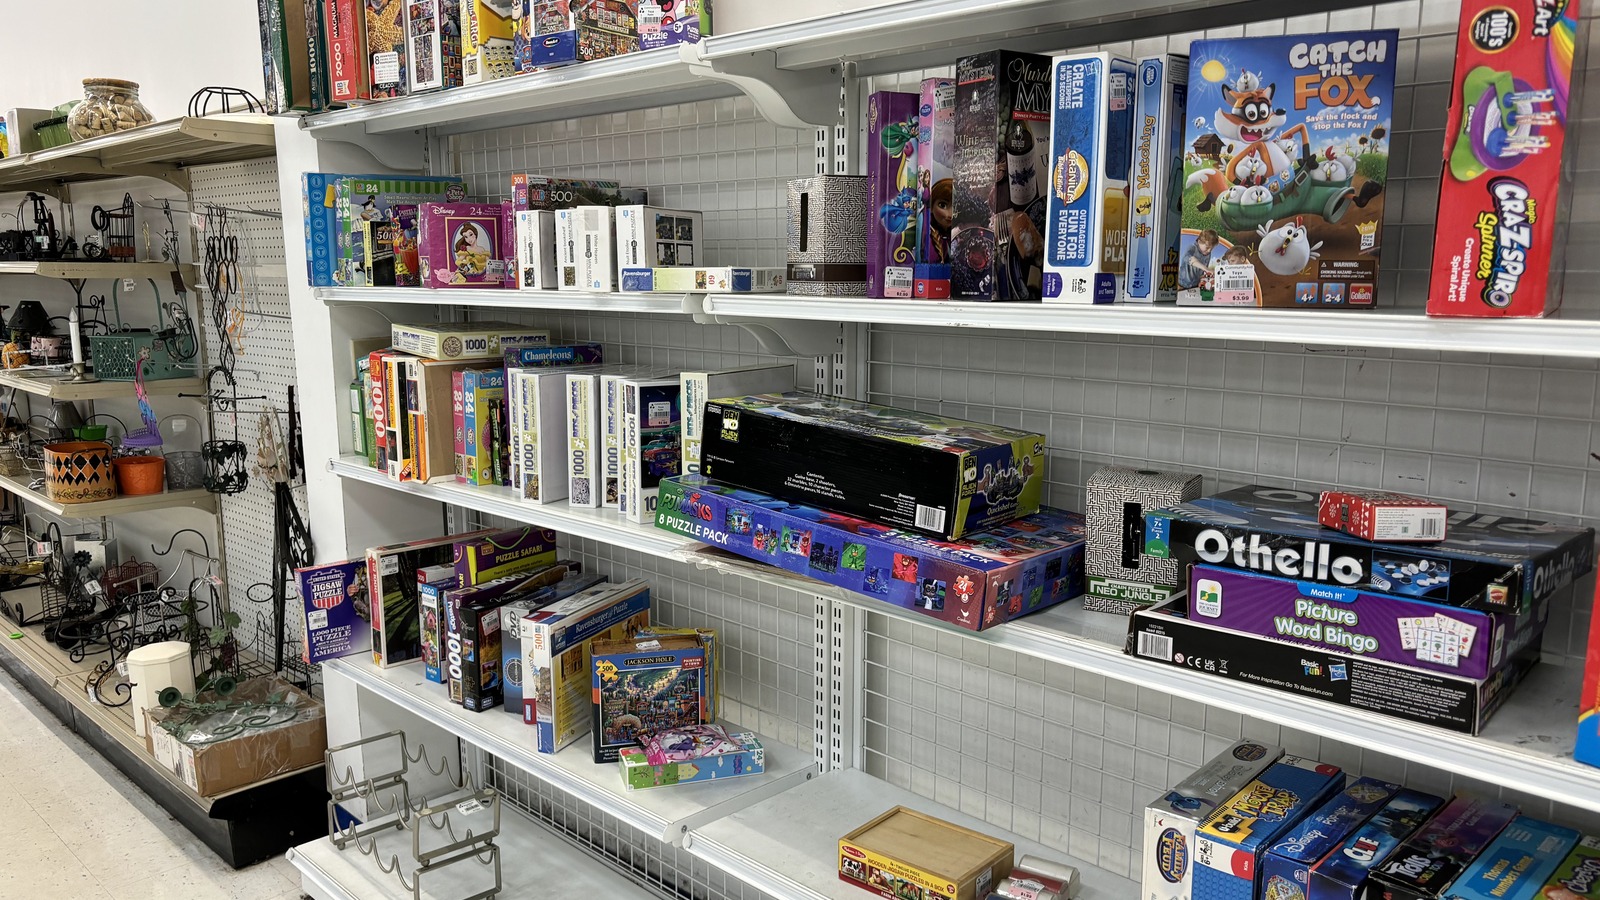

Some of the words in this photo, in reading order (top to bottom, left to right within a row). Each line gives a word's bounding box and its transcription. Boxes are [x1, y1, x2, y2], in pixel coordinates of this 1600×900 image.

[331, 1, 340, 38] MAGNUM
[1489, 12, 1508, 48] 100's
[642, 32, 668, 42] Puzzle
[308, 37, 316, 73] 1000
[334, 42, 342, 77] 2000
[580, 46, 594, 56] 500
[1290, 40, 1387, 69] CATCH
[1319, 62, 1353, 78] THE
[1072, 64, 1084, 109] CREATE
[1294, 74, 1380, 110] FOX
[1314, 123, 1331, 131] stop
[1347, 120, 1367, 129] Fox!
[1137, 116, 1155, 189] Matching
[365, 184, 378, 193] 24
[431, 206, 456, 216] Disney
[470, 206, 483, 216] 24
[1067, 210, 1077, 234] FUN
[1525, 199, 1536, 224] Magic
[1057, 210, 1067, 260] EVERYONE
[1077, 209, 1086, 259] OUTRAGEOUS
[1105, 230, 1126, 244] WOR
[1066, 237, 1076, 259] FOR
[1463, 238, 1474, 269] Create
[1474, 212, 1498, 279] Spinner
[1449, 256, 1461, 283] Spiral
[1448, 284, 1457, 302] Art!
[1459, 269, 1469, 302] Unique
[1325, 294, 1341, 302] 2-4
[464, 339, 486, 350] 1000
[524, 349, 572, 361] Chameleons
[490, 376, 502, 386] 24
[372, 376, 386, 438] 1000
[453, 390, 463, 412] 24
[464, 391, 474, 413] 24
[723, 419, 739, 430] 10
[724, 411, 739, 420] BEN
[524, 444, 534, 471] 1000
[573, 450, 584, 476] 1000
[608, 447, 618, 475] 1000
[964, 457, 977, 468] BEN
[402, 462, 412, 476] NEW
[964, 468, 976, 482] 10
[962, 483, 977, 492] ALIEN
[661, 493, 676, 510] PJ
[675, 493, 713, 521] MASKS
[659, 514, 664, 524] 8
[666, 515, 701, 536] PUZZLE
[703, 527, 729, 545] PACK
[495, 551, 519, 563] PUZZLE
[521, 545, 543, 557] SAFARI
[1195, 529, 1363, 585] Othello
[312, 581, 343, 592] JIGSAW
[488, 571, 532, 587] 1000
[958, 581, 967, 592] 24
[314, 588, 343, 600] PUZZLE
[422, 586, 434, 595] 1000
[1096, 586, 1118, 596] NEO
[1120, 588, 1163, 601] JUNGLE
[1310, 588, 1333, 598] Match
[447, 601, 456, 630] Prestige
[576, 611, 610, 632] Ravensburger
[613, 601, 629, 615] Puzzle
[1296, 600, 1357, 624] Picture
[312, 630, 352, 643] PUZZLE
[329, 625, 351, 633] PIECE
[1276, 617, 1322, 640] Word
[1325, 623, 1378, 653] Bingo
[313, 645, 352, 658] AMERICA
[447, 631, 462, 679] 1000
[1301, 659, 1319, 668] Basic
[1304, 666, 1323, 676] Fun!
[1261, 676, 1285, 686] Inspiration
[1300, 685, 1334, 697] Basicfun.com
[756, 750, 763, 760] 24
[1231, 785, 1274, 817] MOUSE
[1258, 790, 1298, 820] TRAP
[1274, 830, 1328, 852] Disney
[1343, 836, 1380, 861] CLUE
[1162, 837, 1173, 871] FEUD
[1172, 832, 1187, 883] FAMILY
[1204, 856, 1211, 866] 6+
[868, 859, 887, 870] WOODEN
[888, 866, 905, 876] JIGSAW
[905, 873, 925, 884] PUZZLES
[1381, 855, 1431, 878] Trolls
[1483, 859, 1510, 881] Thomas
[1491, 870, 1517, 896] Numbers
[1515, 855, 1534, 872] Game
